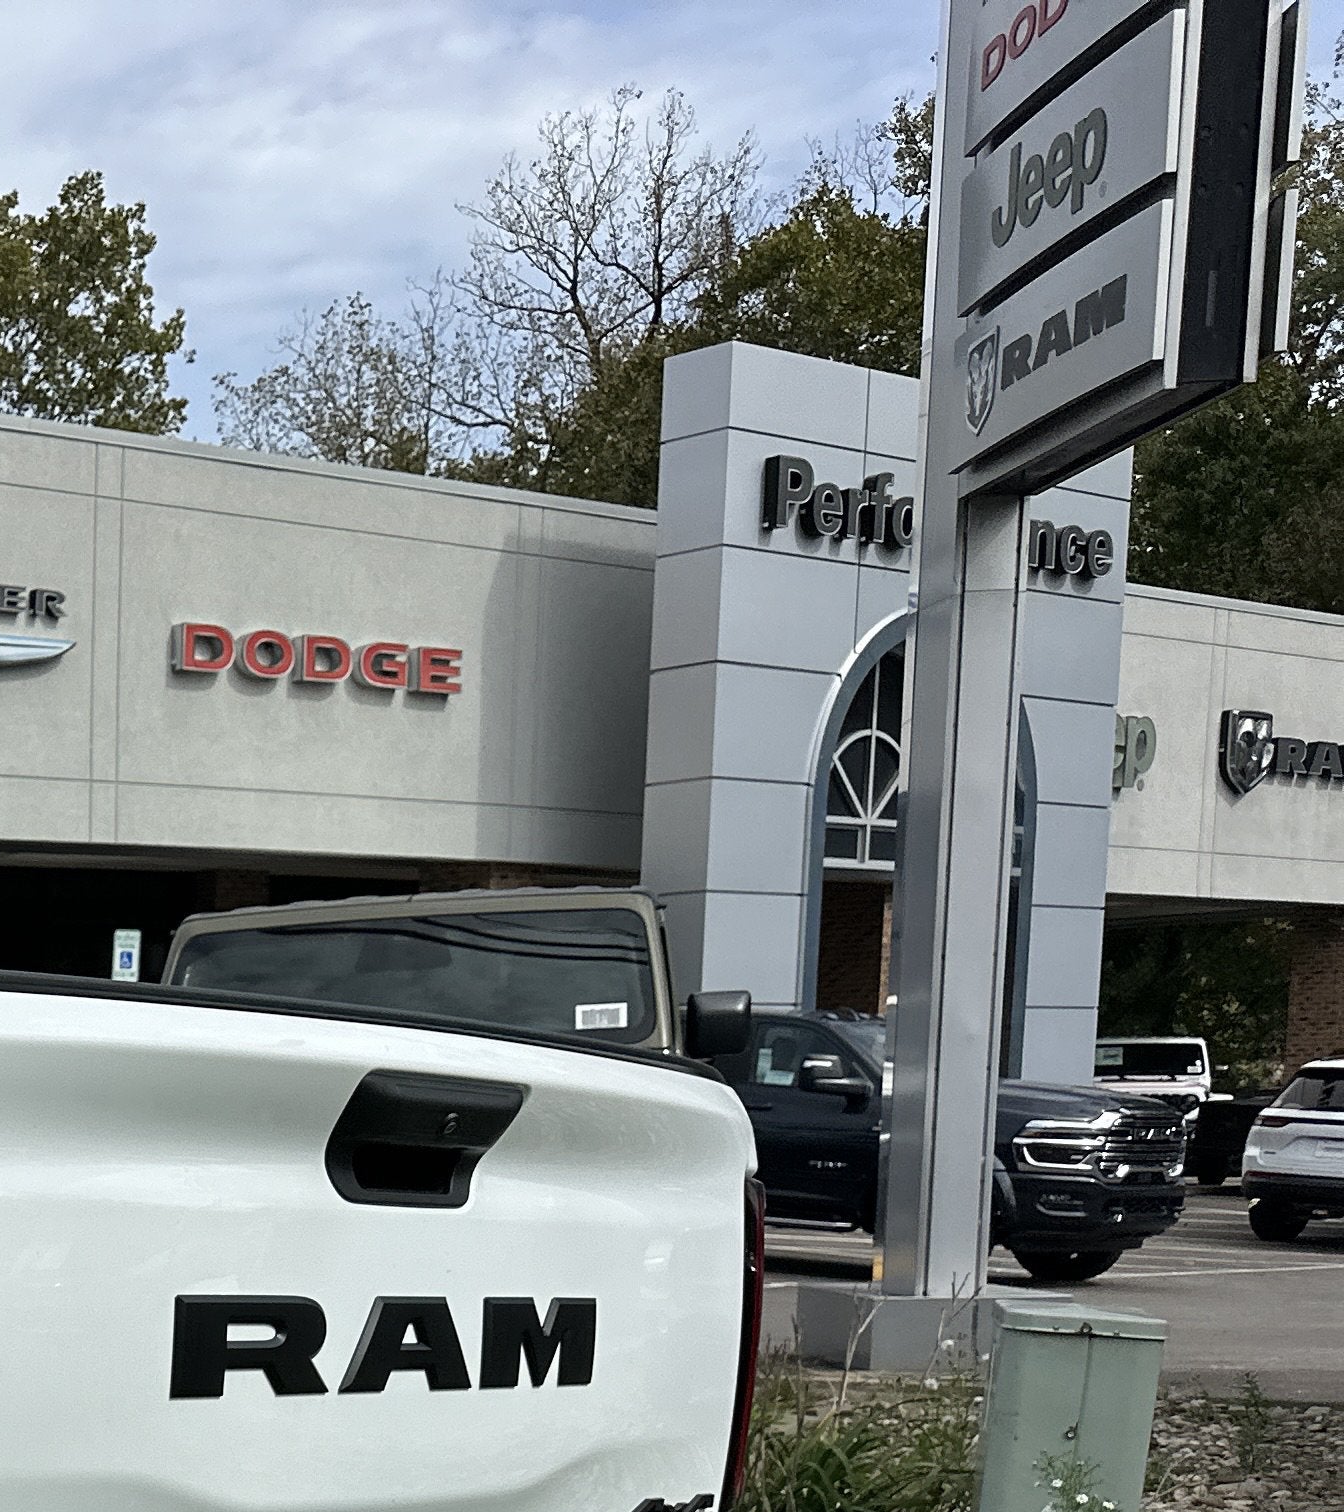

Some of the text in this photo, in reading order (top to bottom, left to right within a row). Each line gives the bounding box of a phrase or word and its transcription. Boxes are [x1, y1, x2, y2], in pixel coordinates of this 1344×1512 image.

[991, 107, 1108, 248] Jeep
[1000, 273, 1127, 391] RAM
[763, 454, 1114, 578] Perfonce
[170, 621, 463, 694] DODGE
[1270, 737, 1344, 779] RA
[169, 1294, 598, 1400] RAM
